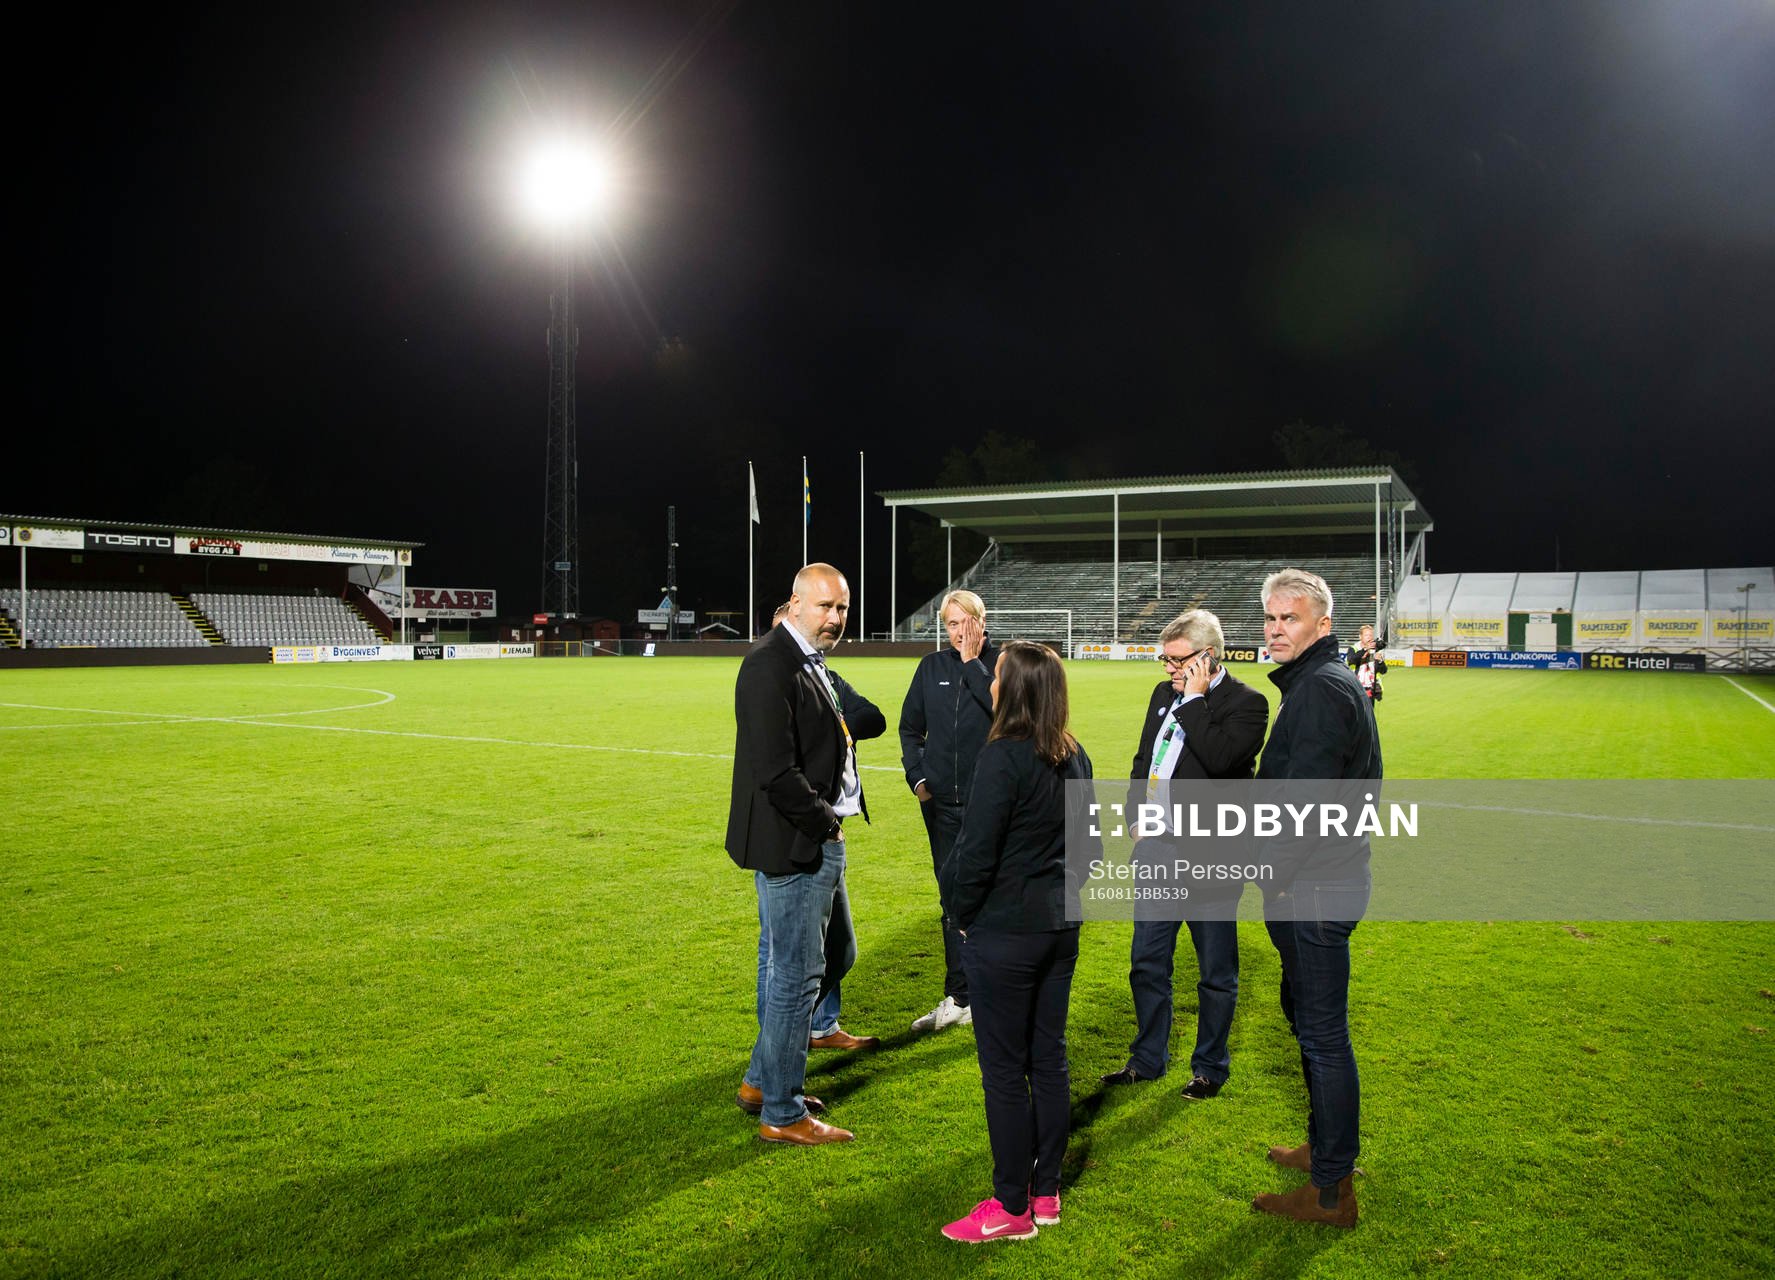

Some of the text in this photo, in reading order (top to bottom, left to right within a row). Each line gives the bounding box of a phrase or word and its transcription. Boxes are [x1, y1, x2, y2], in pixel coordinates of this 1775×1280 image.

[88, 533, 172, 547] TOSITO
[198, 546, 234, 555] BYGG AB
[413, 589, 493, 610] KABE
[1397, 622, 1439, 630] RAMIRENT
[1456, 621, 1501, 630] RAMIRENT
[1580, 623, 1628, 632] RAMIRENT
[1648, 622, 1698, 631] RAMIRENT
[1717, 622, 1770, 631] RAMIRENT
[333, 647, 381, 657] BYGGINVEST
[417, 646, 440, 656] velvet
[508, 647, 532, 655] JEMAB
[1509, 652, 1558, 661] JÖNKÖPING
[1628, 657, 1670, 669] Hotel
